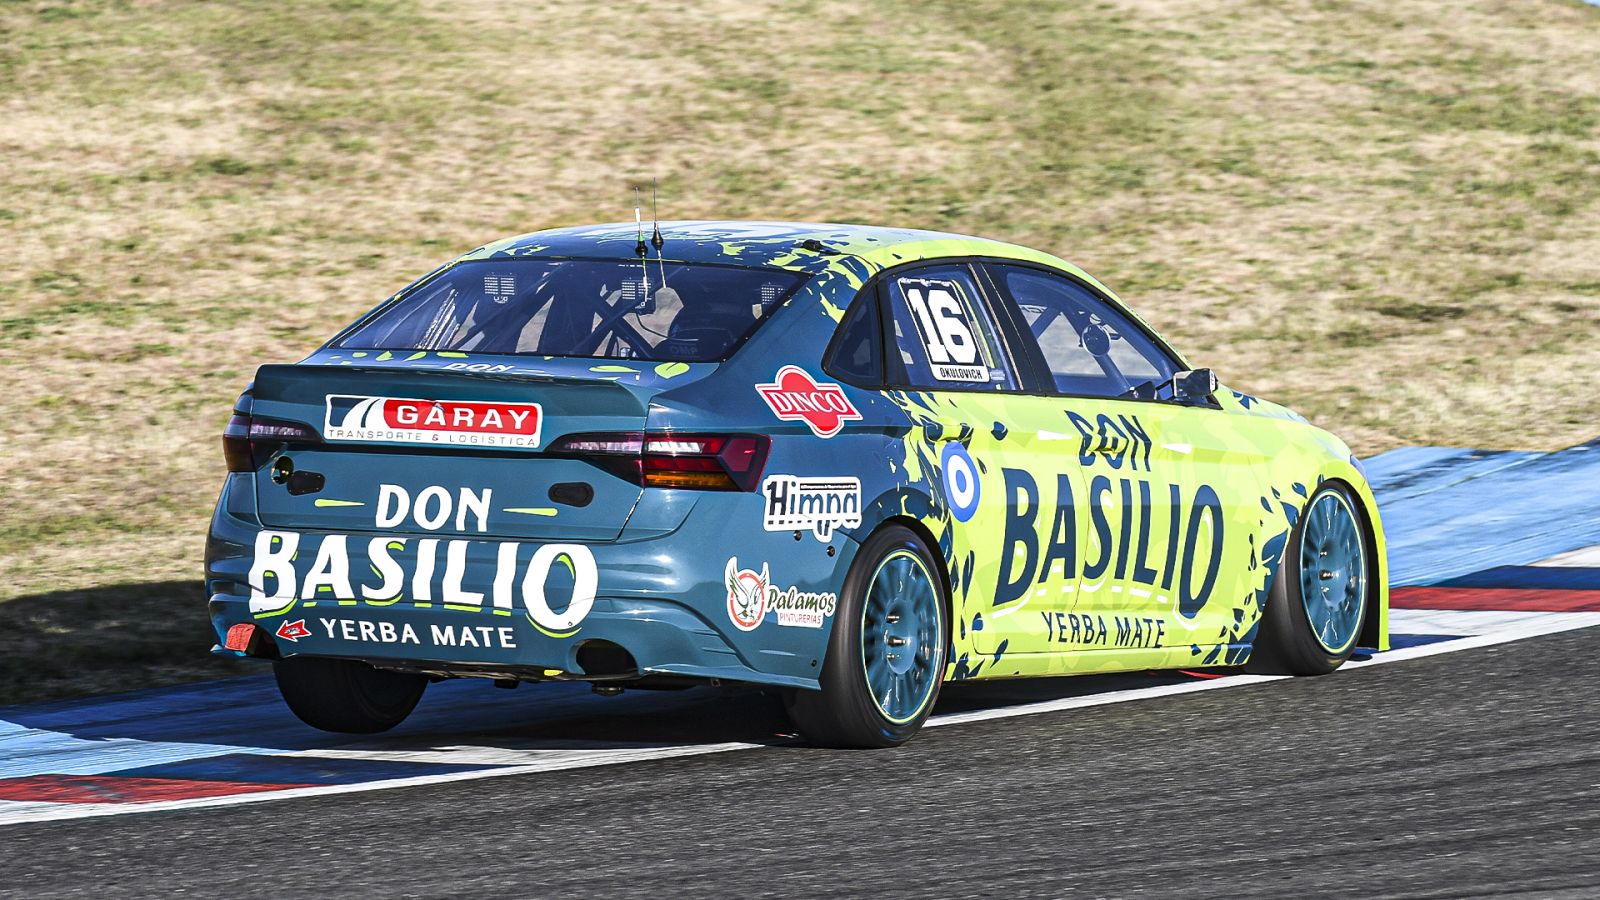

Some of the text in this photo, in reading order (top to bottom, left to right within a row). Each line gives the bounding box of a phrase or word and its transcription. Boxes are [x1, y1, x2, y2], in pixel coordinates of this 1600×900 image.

[907, 289, 977, 364] 16
[441, 363, 515, 373] DON
[940, 367, 983, 379] OKULOVICH
[396, 404, 531, 430] GARAY
[768, 392, 848, 413] DINCO
[329, 430, 422, 441] TRANSPORTE
[432, 434, 439, 442] &
[1064, 410, 1153, 472] DON
[376, 484, 493, 532] DON
[992, 467, 1224, 619] BASILIO
[248, 530, 600, 632] BASILIO
[767, 588, 835, 613] Palamos
[780, 612, 821, 624] PINTURERIAS
[1041, 612, 1165, 649] YERBA MATE
[319, 617, 517, 649] YERBA MATE
